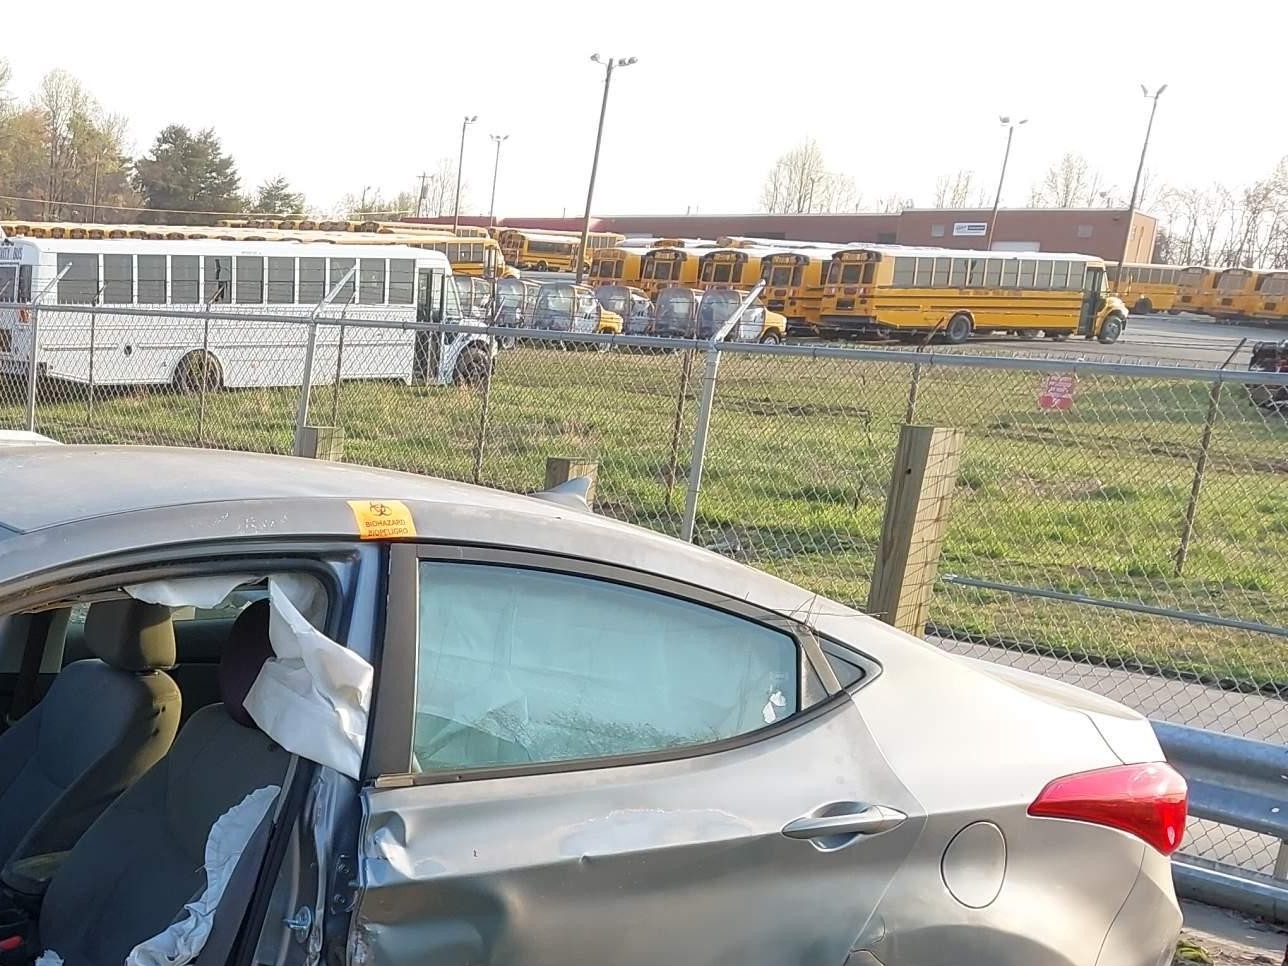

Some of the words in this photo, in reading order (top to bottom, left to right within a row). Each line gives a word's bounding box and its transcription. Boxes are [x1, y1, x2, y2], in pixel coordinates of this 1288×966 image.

[12, 247, 24, 260] BUS
[365, 519, 406, 527] BIOHAZARD
[367, 527, 409, 537] BIOPELIGRO
